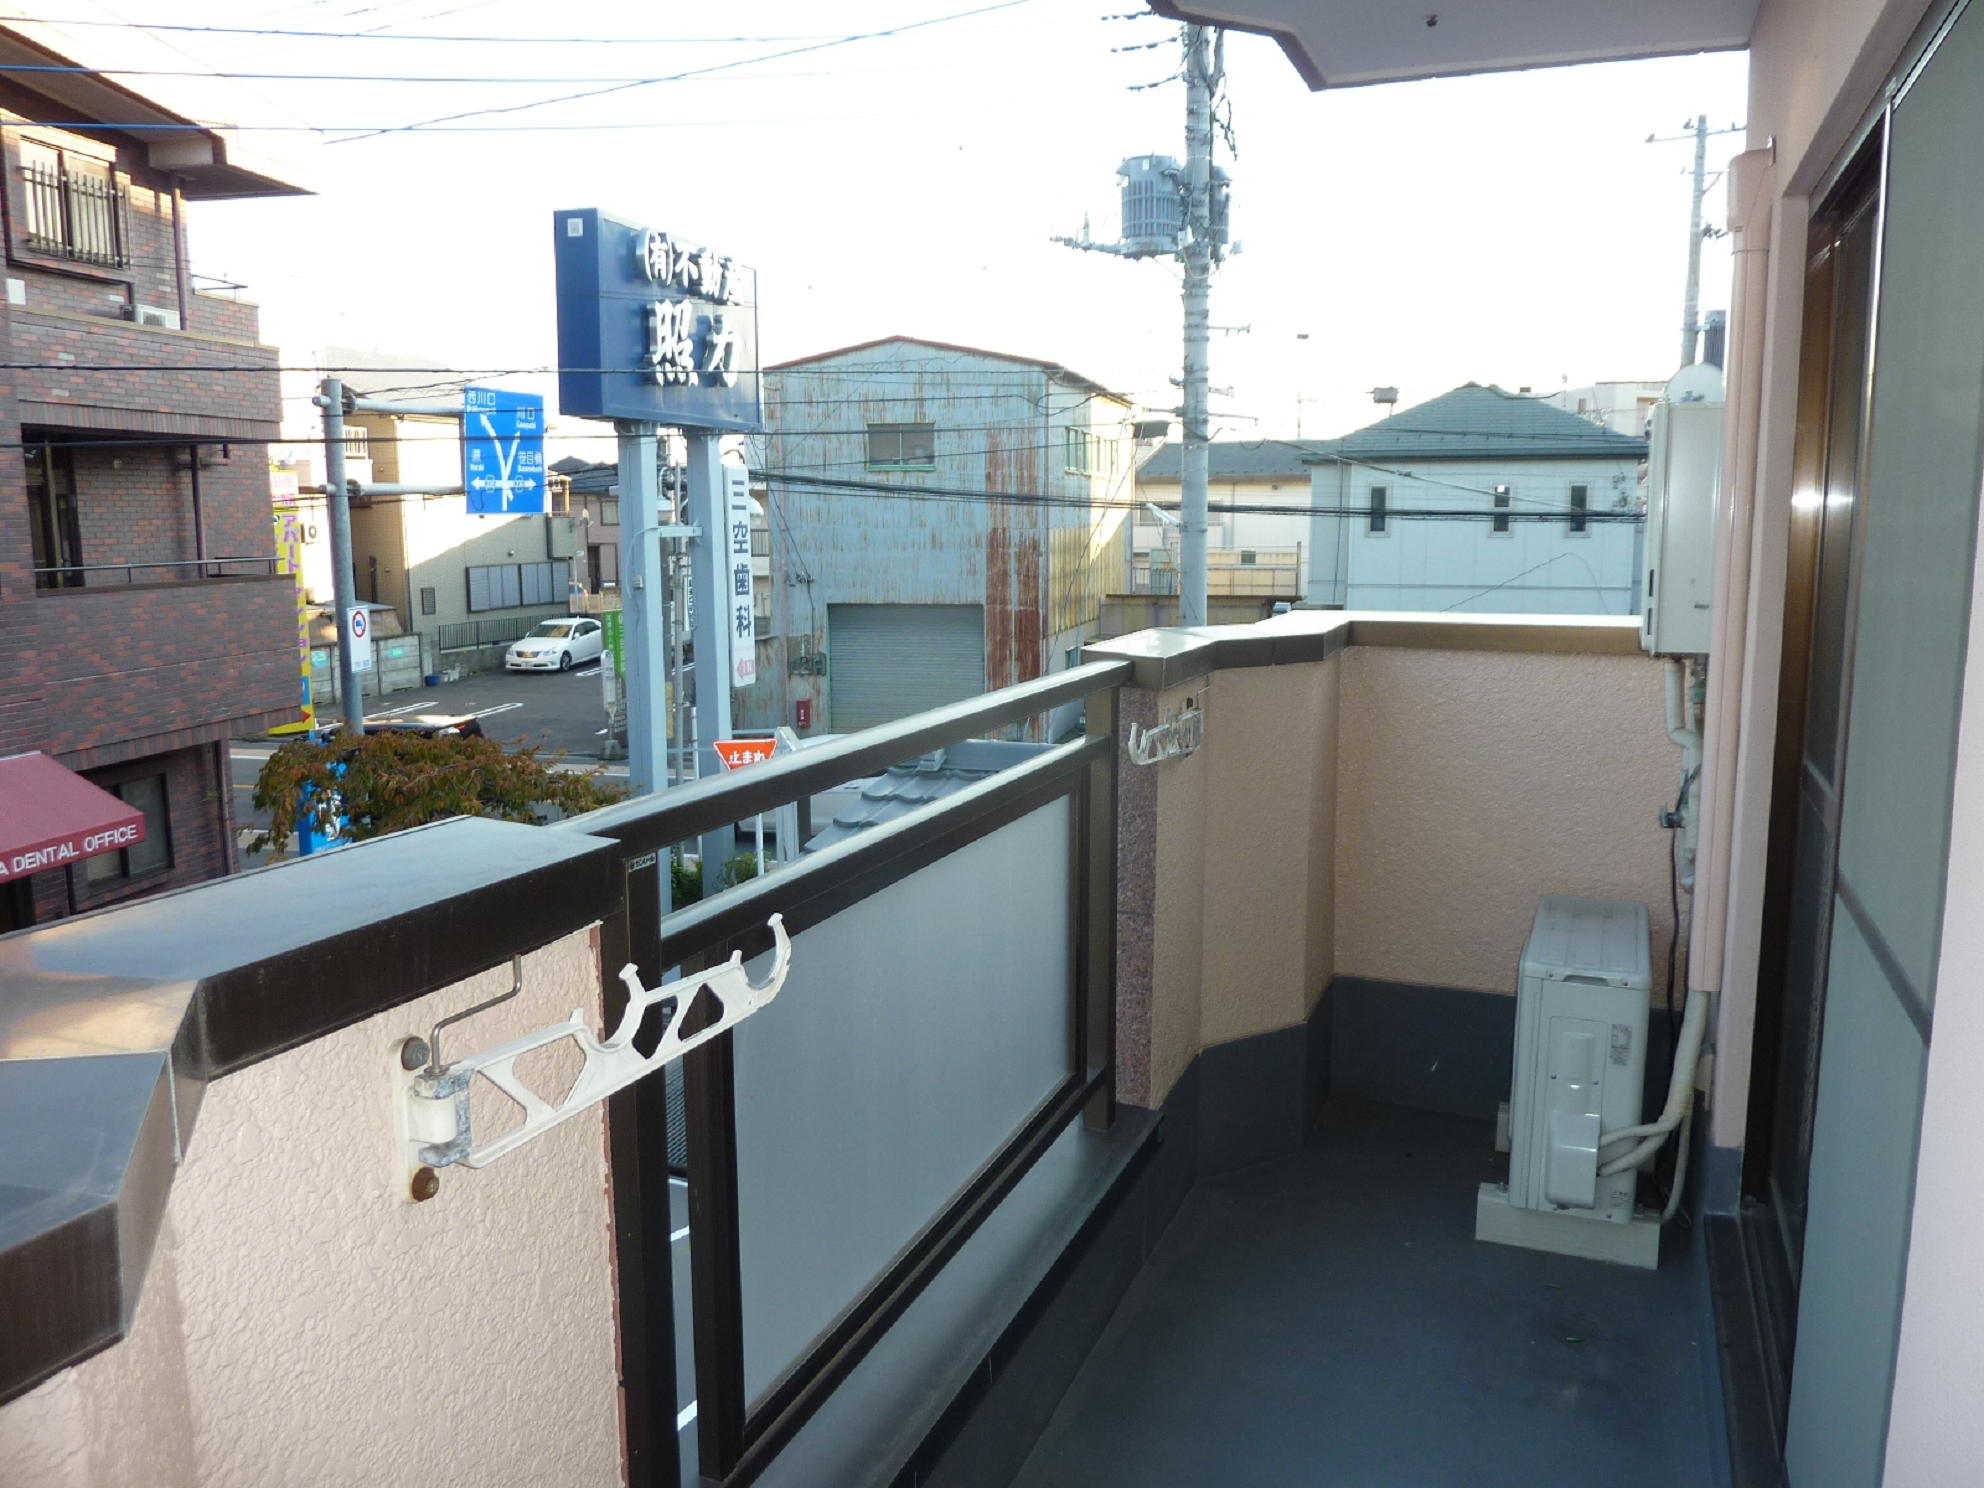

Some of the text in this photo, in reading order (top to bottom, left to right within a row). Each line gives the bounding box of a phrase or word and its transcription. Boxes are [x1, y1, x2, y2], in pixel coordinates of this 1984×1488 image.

[731, 479, 752, 639] 三空歯科
[728, 749, 766, 764] 止まれ
[12, 842, 79, 873] DENTAL
[84, 824, 139, 852] OFFICE
